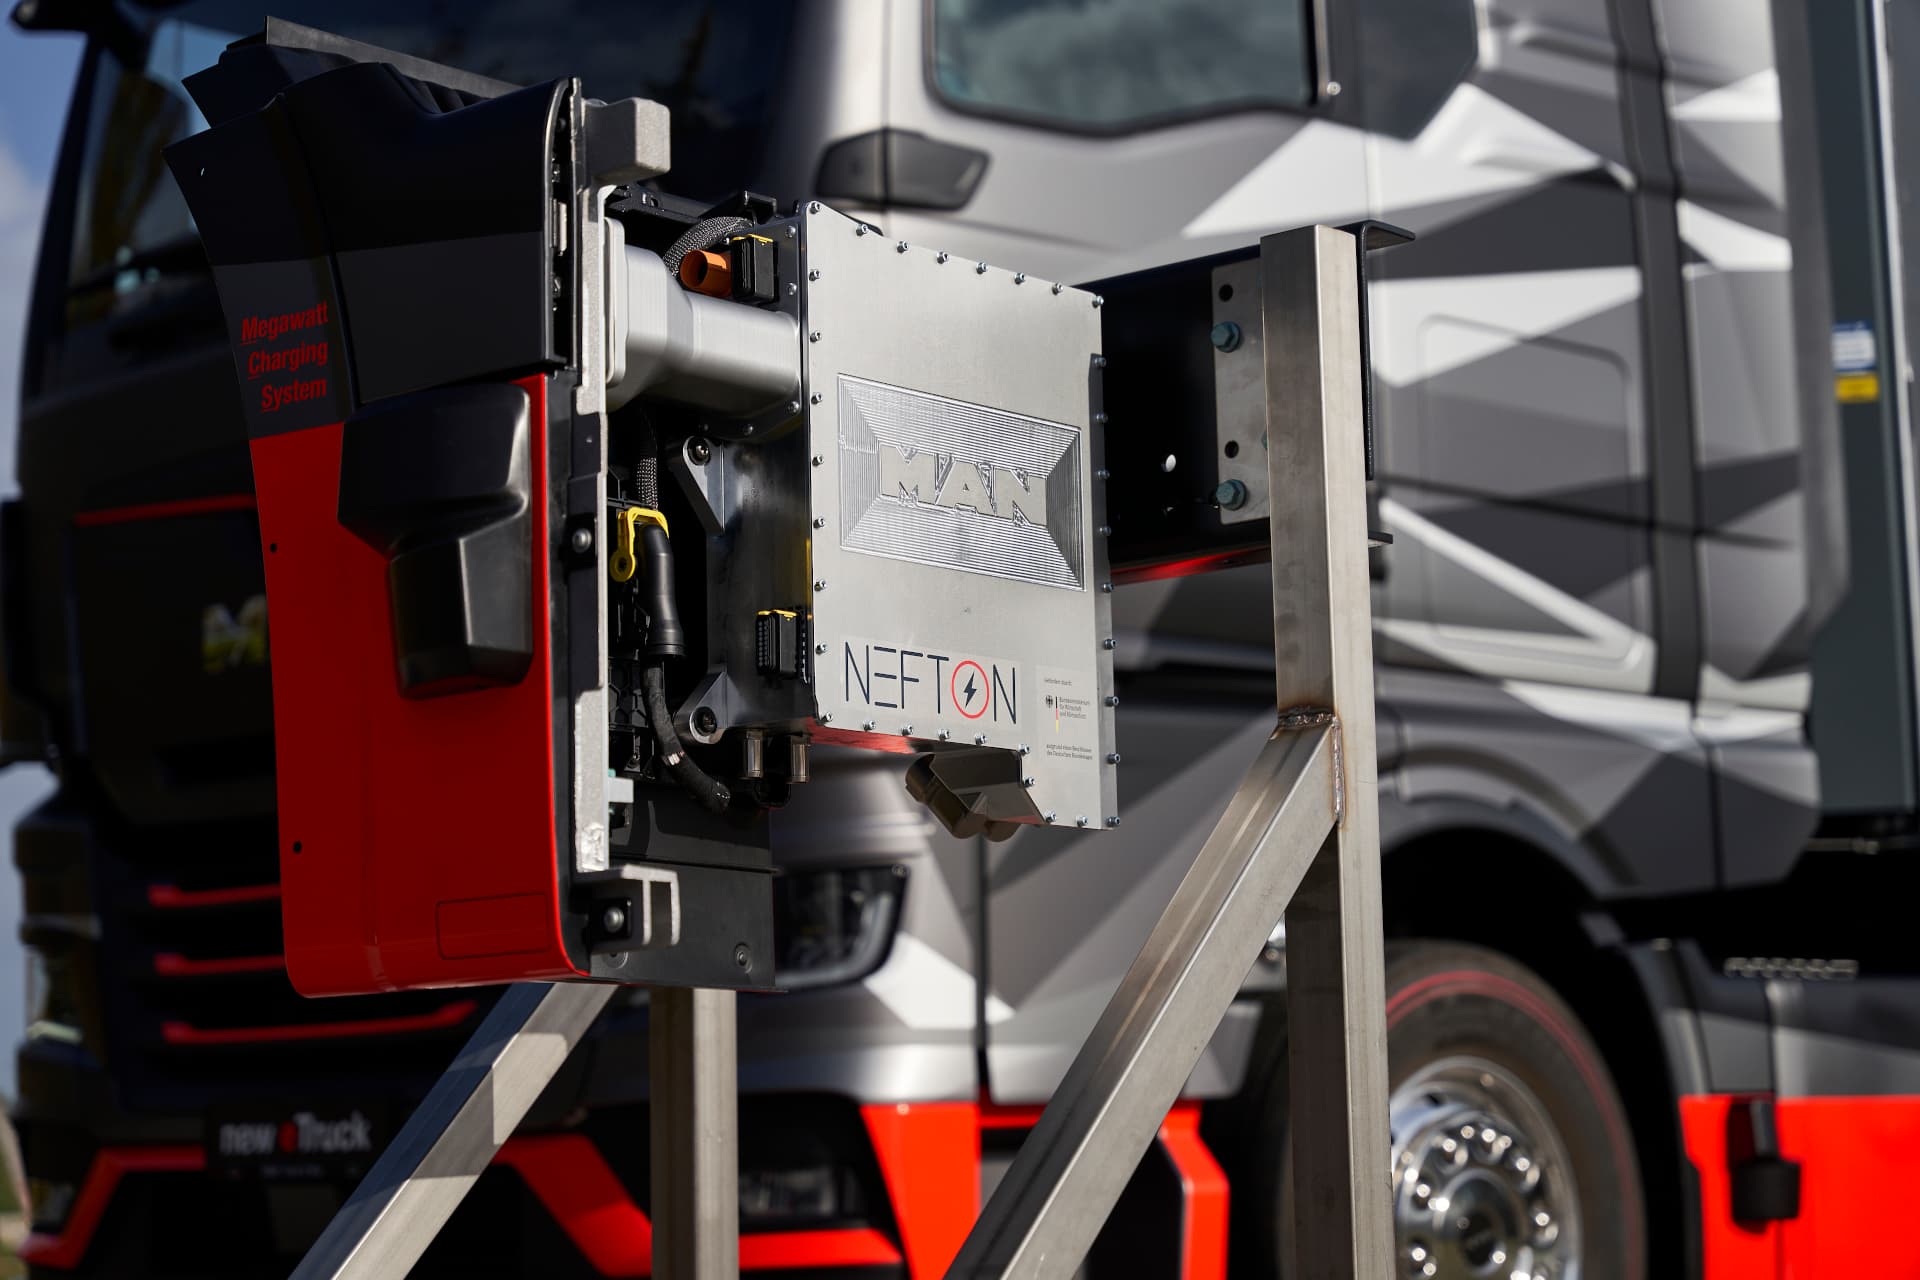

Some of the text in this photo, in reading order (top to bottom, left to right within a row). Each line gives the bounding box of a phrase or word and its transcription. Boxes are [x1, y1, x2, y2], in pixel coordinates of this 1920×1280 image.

[242, 300, 328, 342] Megawatt
[248, 341, 328, 375] Charging
[261, 379, 327, 411] System
[879, 443, 1048, 528] MAN
[845, 641, 1017, 725] NEFTON
[219, 1122, 275, 1155] new
